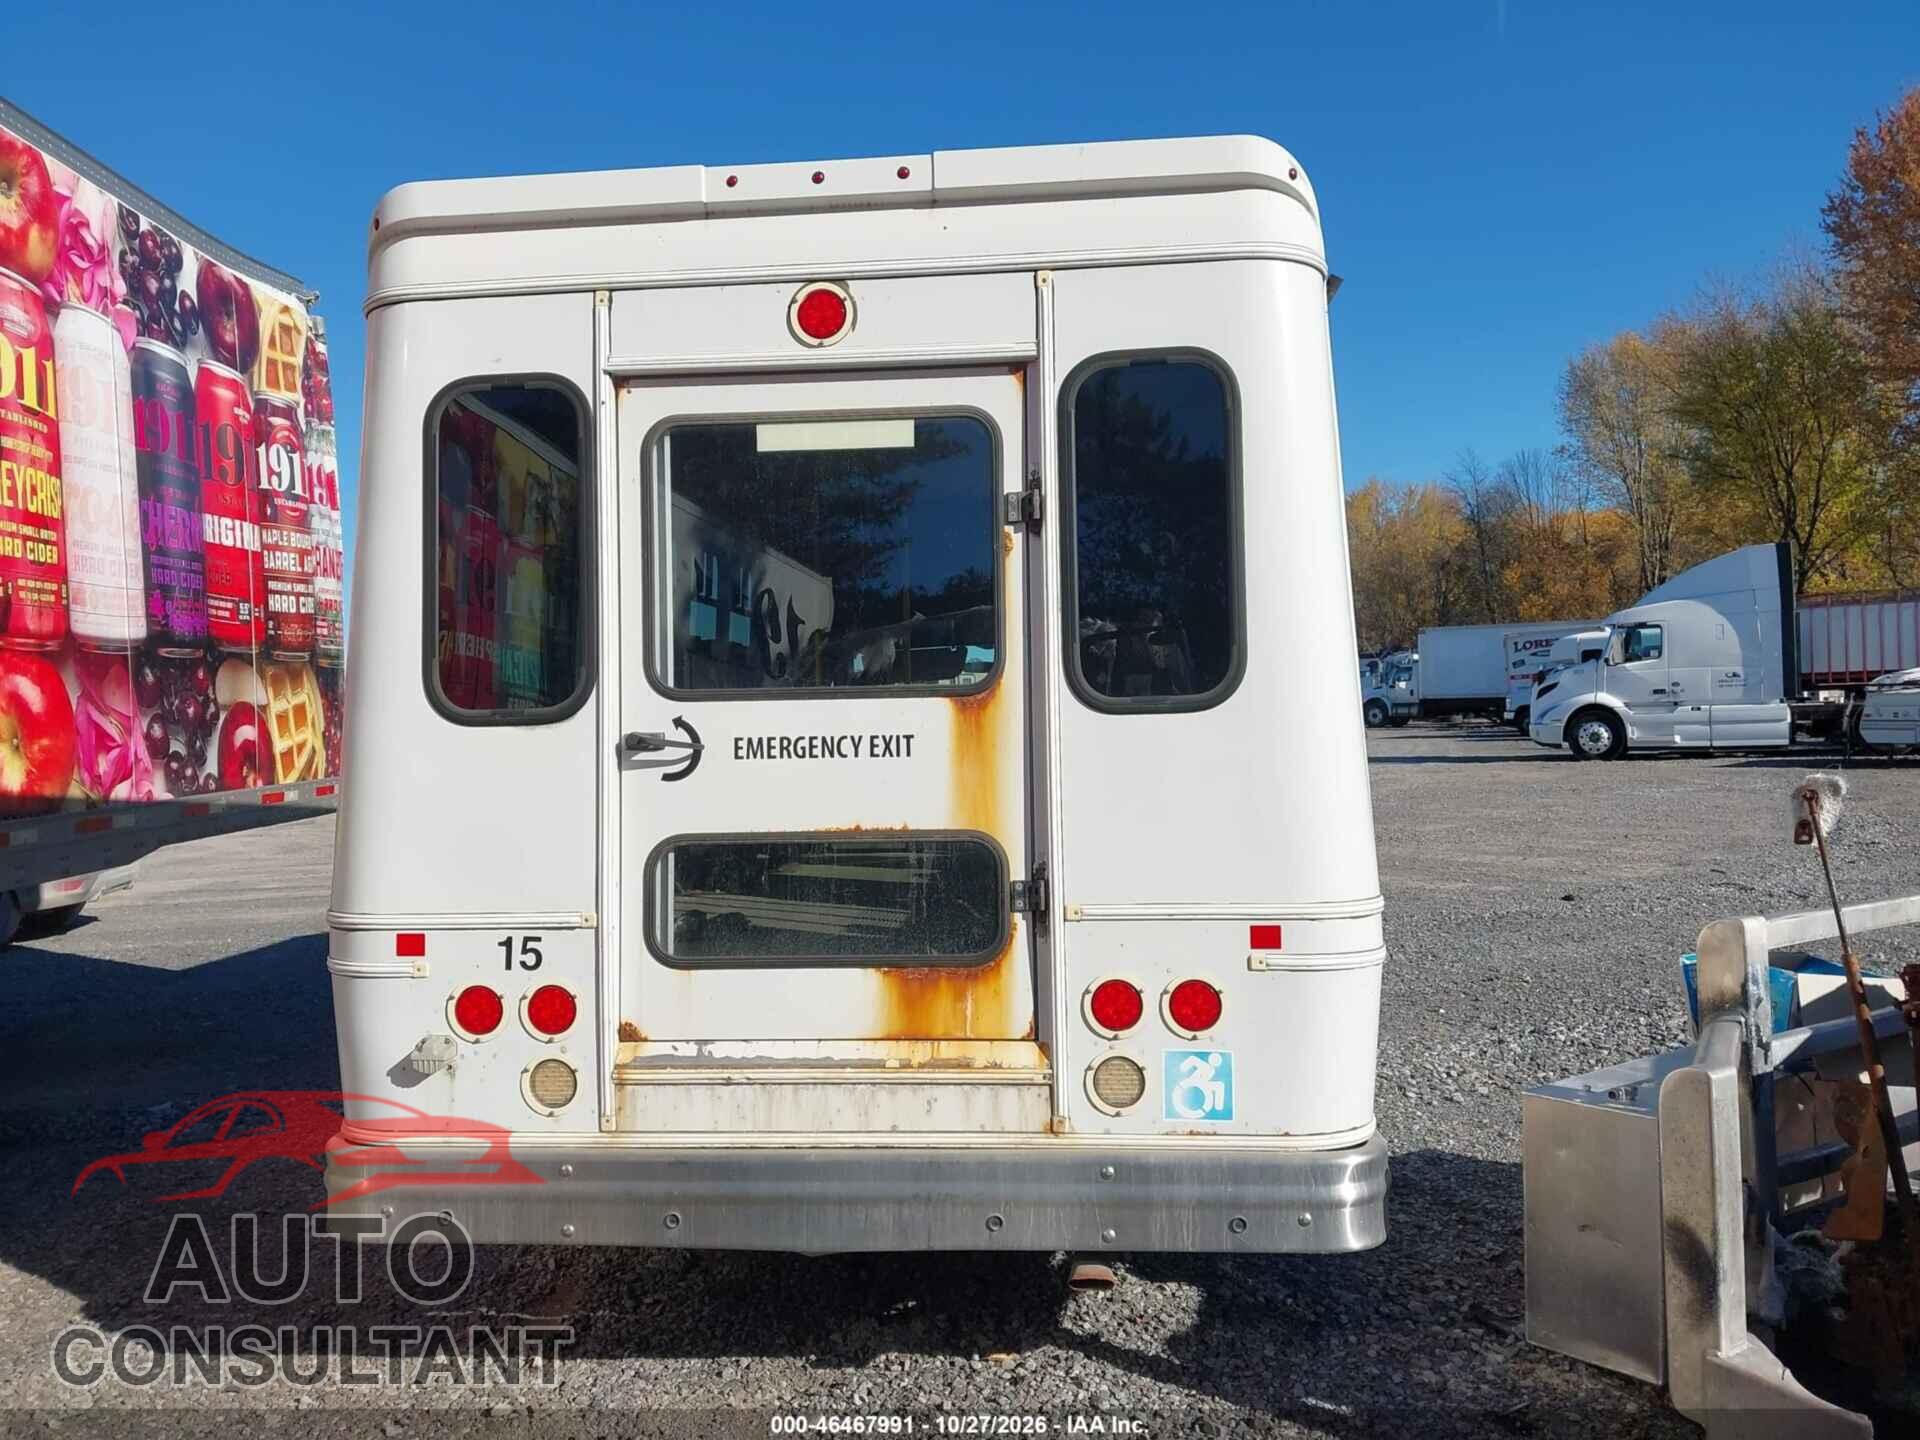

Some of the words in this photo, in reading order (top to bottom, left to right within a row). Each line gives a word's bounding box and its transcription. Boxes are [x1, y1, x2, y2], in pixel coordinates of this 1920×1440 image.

[26, 540, 58, 565] CIDER
[263, 550, 302, 572] BARREL
[268, 593, 297, 614] HARD
[1513, 637, 1559, 653] LORE
[733, 735, 864, 760] EMERGENCY
[869, 734, 915, 758] EXIT
[497, 936, 543, 971] 15
